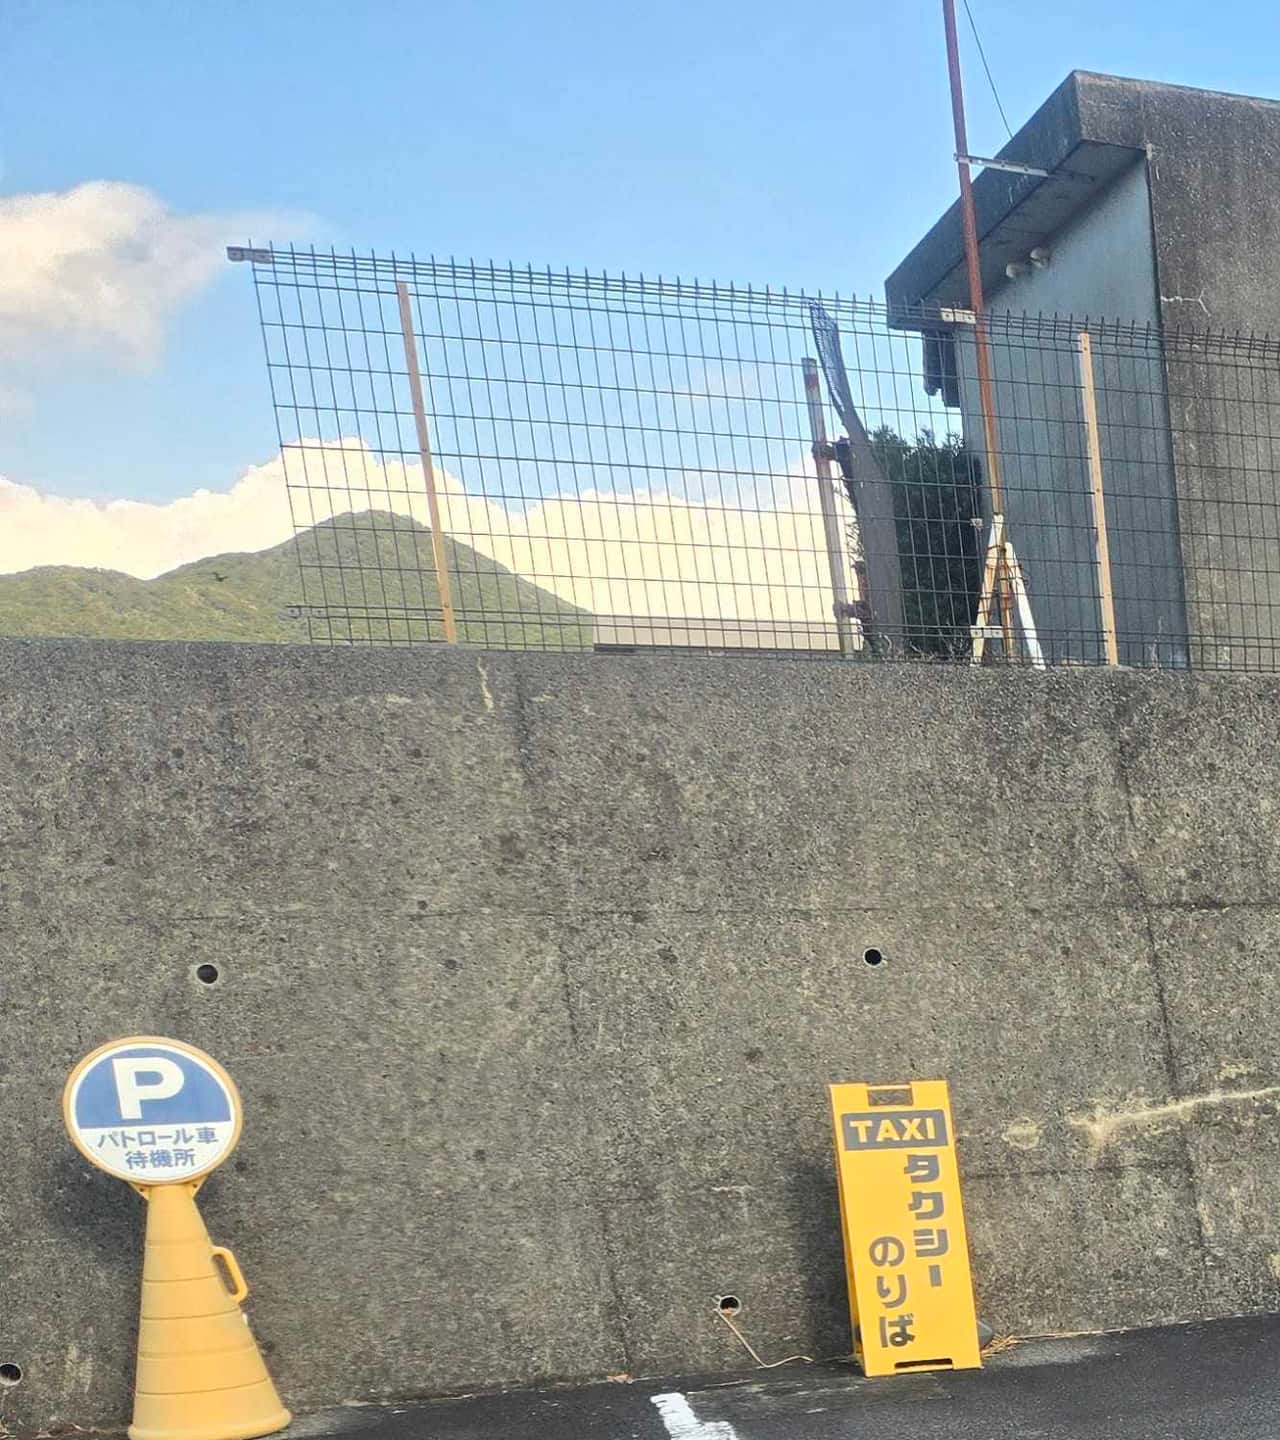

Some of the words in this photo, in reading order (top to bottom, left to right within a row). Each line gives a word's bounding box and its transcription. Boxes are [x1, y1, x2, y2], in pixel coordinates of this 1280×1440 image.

[112, 1057, 185, 1120] P
[98, 1127, 219, 1148] パトロール車
[849, 1117, 936, 1144] TAXI
[125, 1148, 196, 1169] 待機所
[903, 1154, 949, 1288] タクシー
[868, 1236, 915, 1347] のりば
